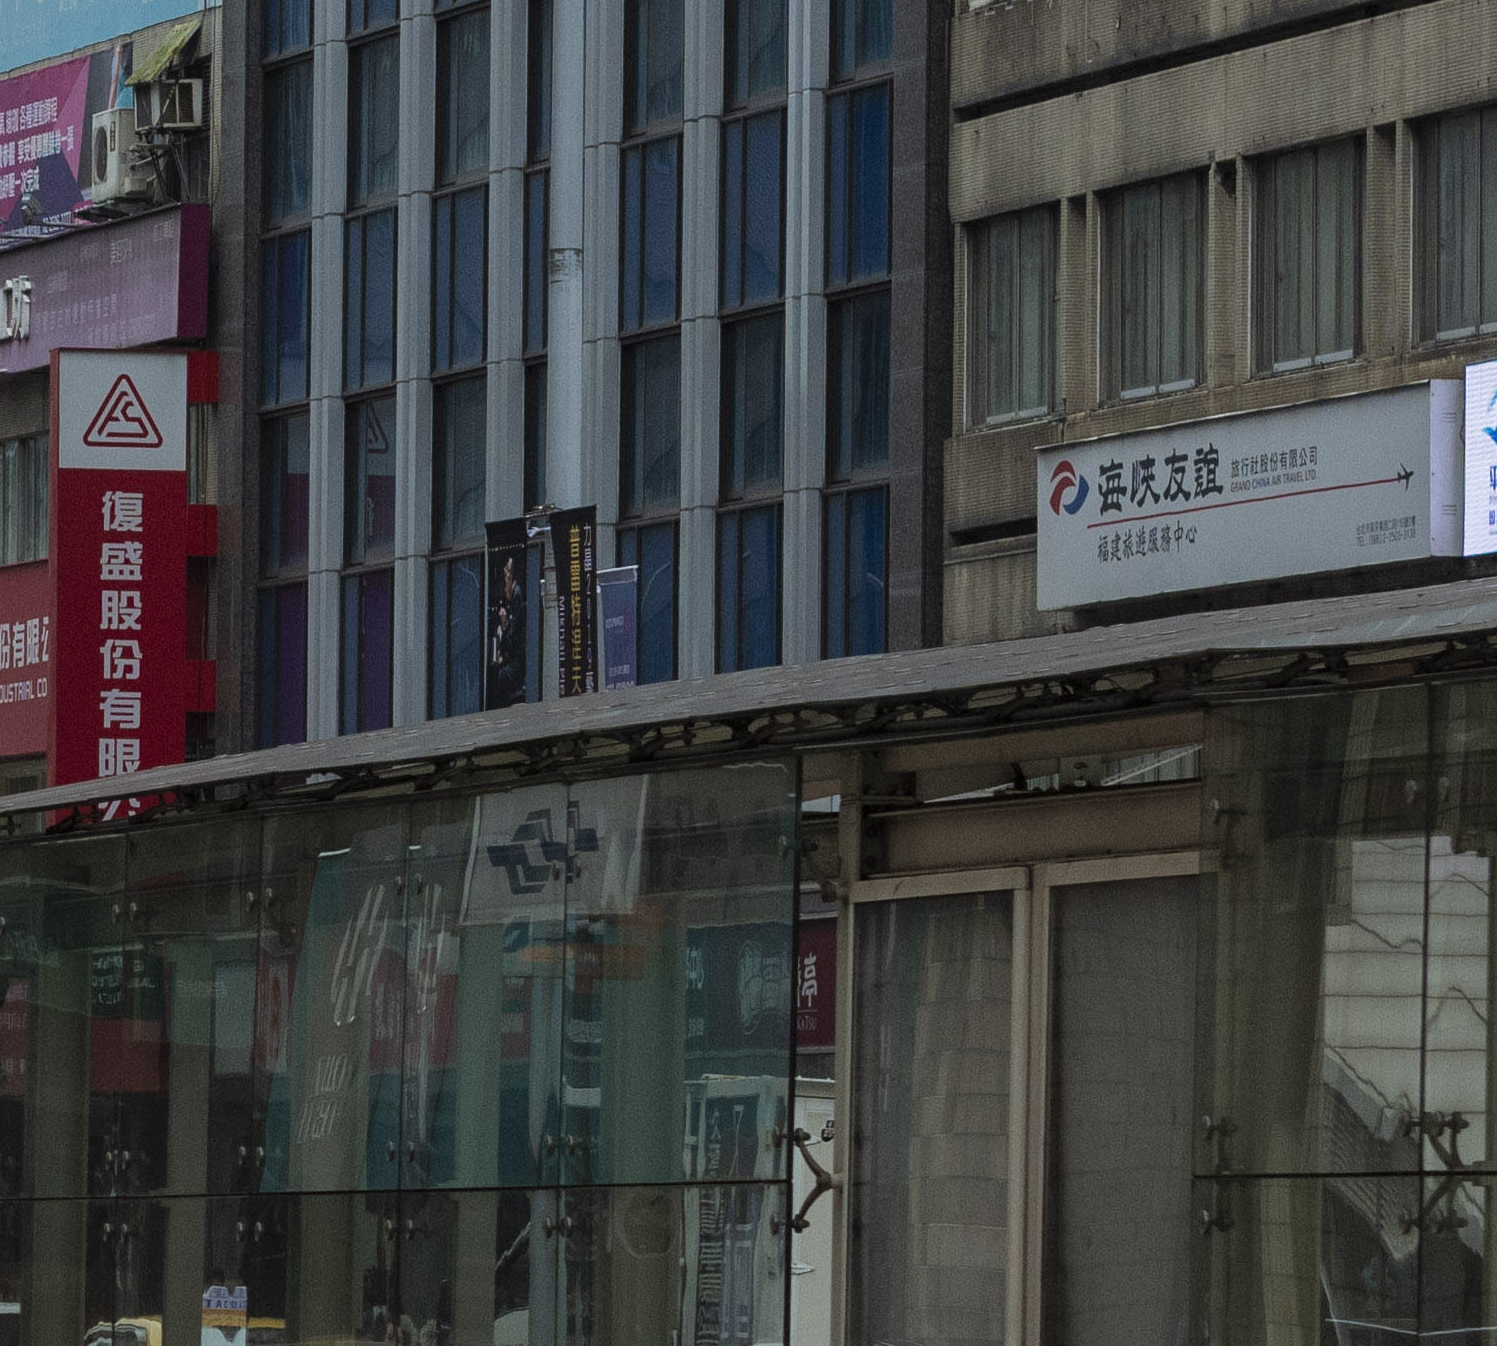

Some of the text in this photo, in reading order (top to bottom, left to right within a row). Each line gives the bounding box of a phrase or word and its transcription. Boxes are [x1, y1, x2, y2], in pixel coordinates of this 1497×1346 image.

[1097, 442, 1319, 517] 海峽友誼 旅行社股份有限公司
